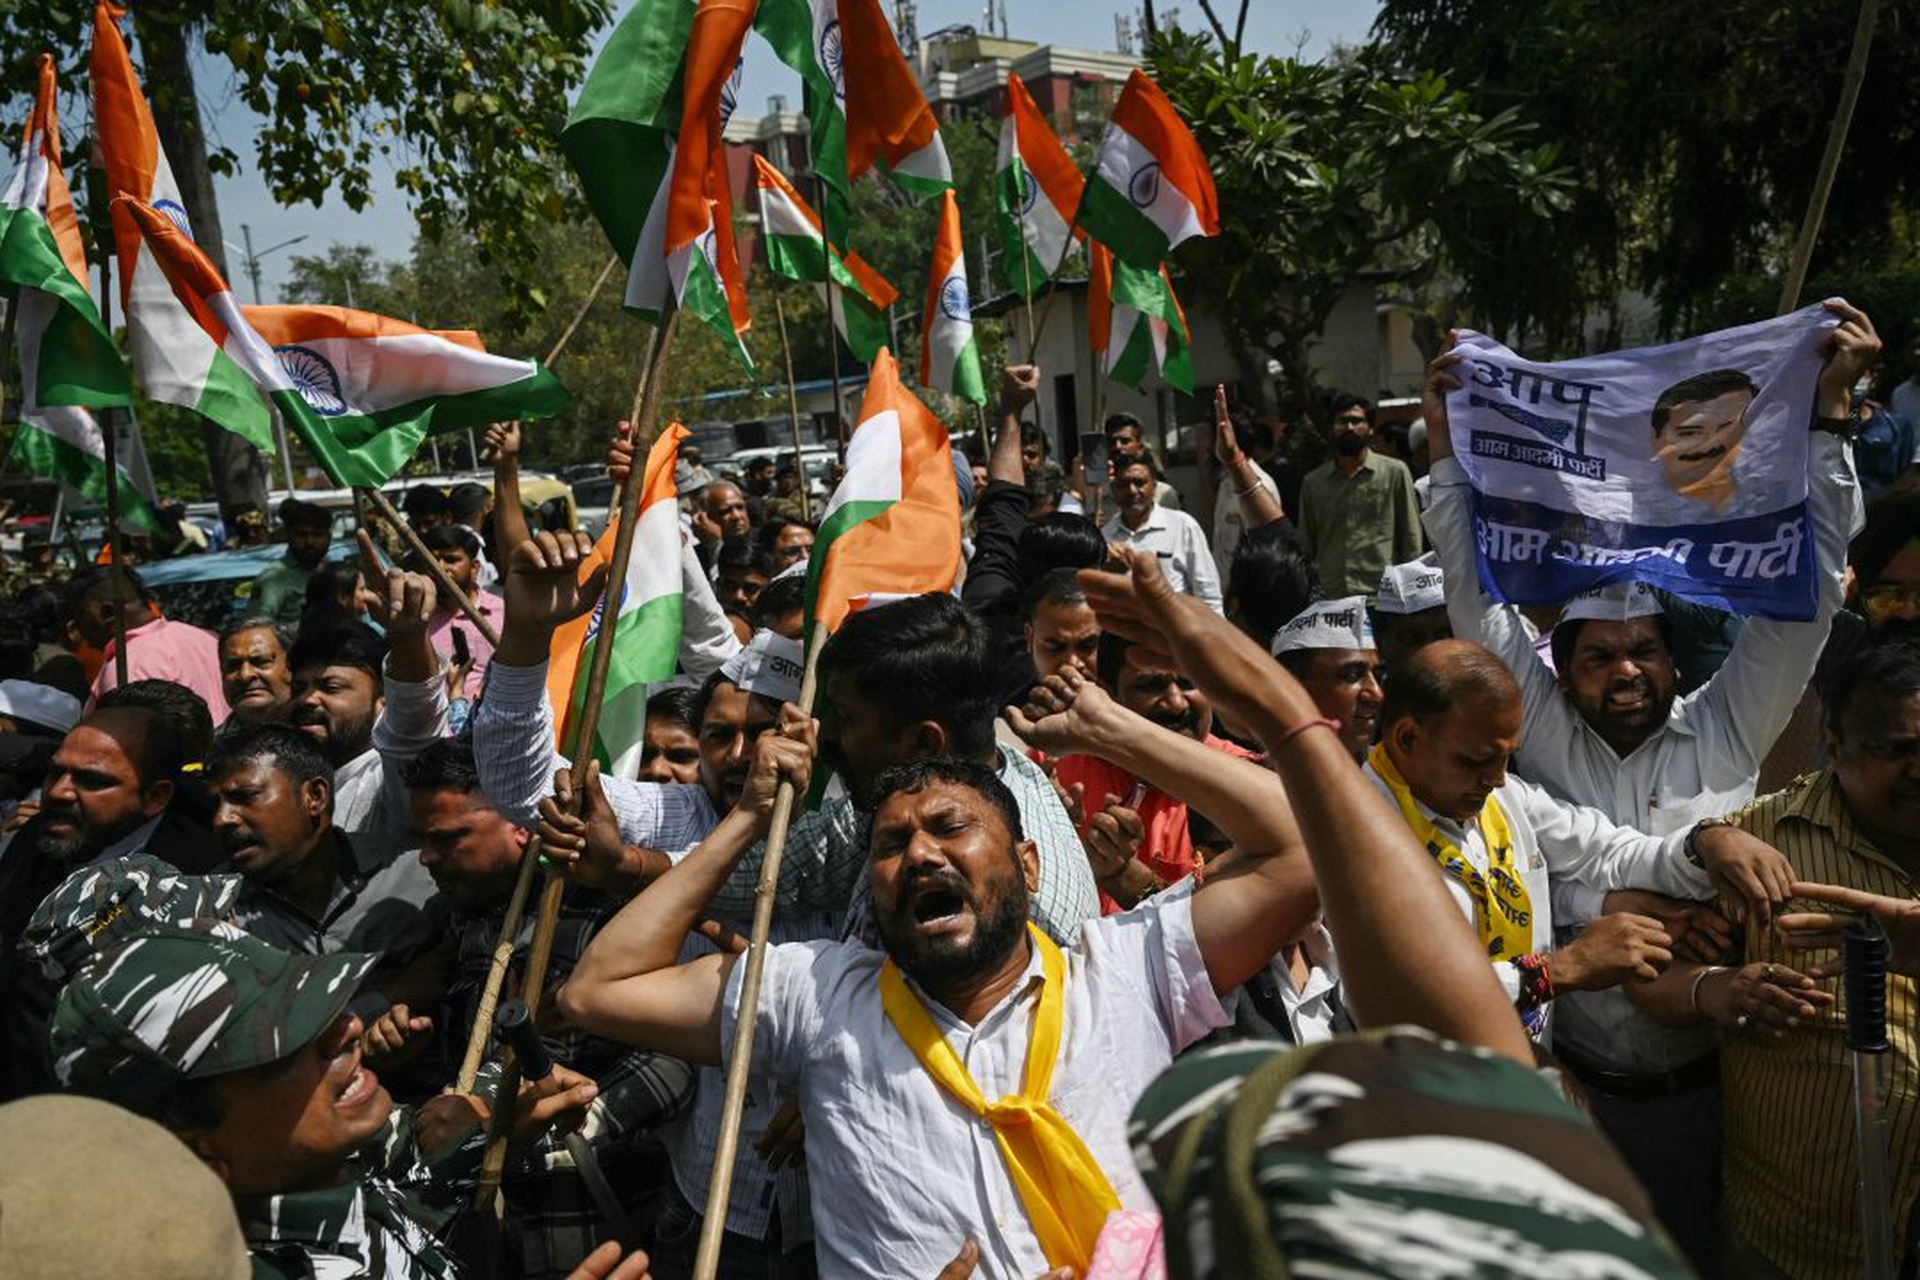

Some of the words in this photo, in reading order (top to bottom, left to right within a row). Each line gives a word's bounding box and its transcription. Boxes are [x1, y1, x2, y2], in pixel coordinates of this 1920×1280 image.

[1470, 359, 1604, 455] आप
[1474, 439, 1510, 456] आम
[1512, 443, 1564, 468] आदमी
[1568, 458, 1602, 479] पार्टी
[1477, 516, 1550, 564] आम
[1709, 518, 1804, 578] पार्टी
[1322, 607, 1355, 628] पार्टी
